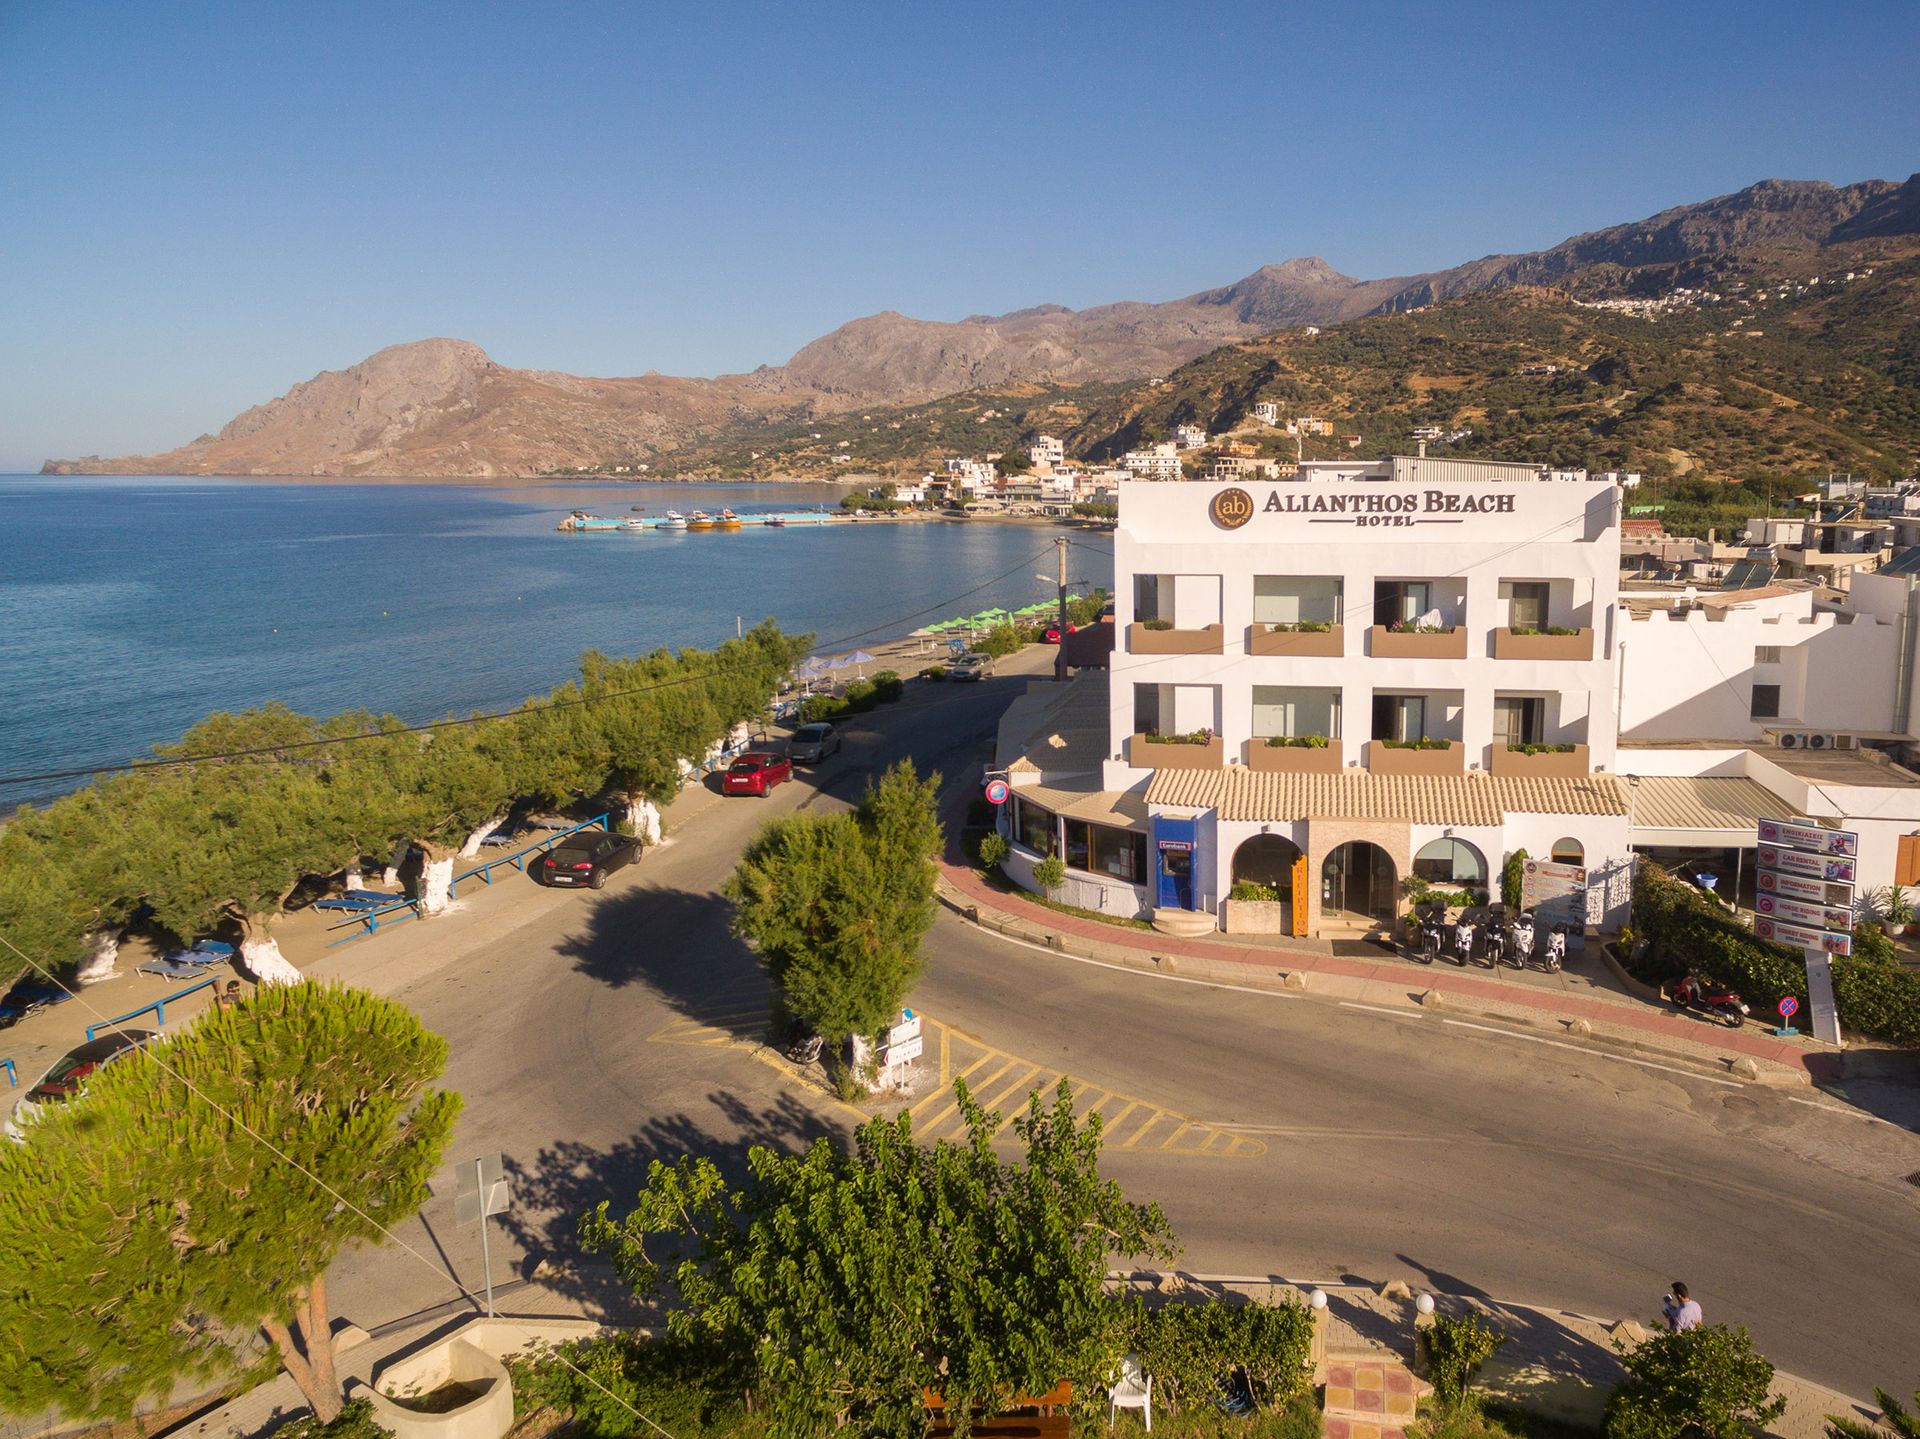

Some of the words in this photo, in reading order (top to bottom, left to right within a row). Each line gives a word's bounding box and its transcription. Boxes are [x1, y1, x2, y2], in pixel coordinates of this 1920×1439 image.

[1222, 495, 1245, 515] ab
[1262, 490, 1418, 513] ALIANTHOS
[1423, 490, 1516, 513] BEACH
[1355, 515, 1416, 527] HOTEL
[1782, 854, 1795, 862] CAR
[1796, 856, 1820, 866] RENTAL
[1780, 879, 1822, 892] INFORMATION
[1779, 903, 1799, 912] HORSE
[1800, 907, 1821, 916] RIDING
[1800, 932, 1819, 941] RIDING
